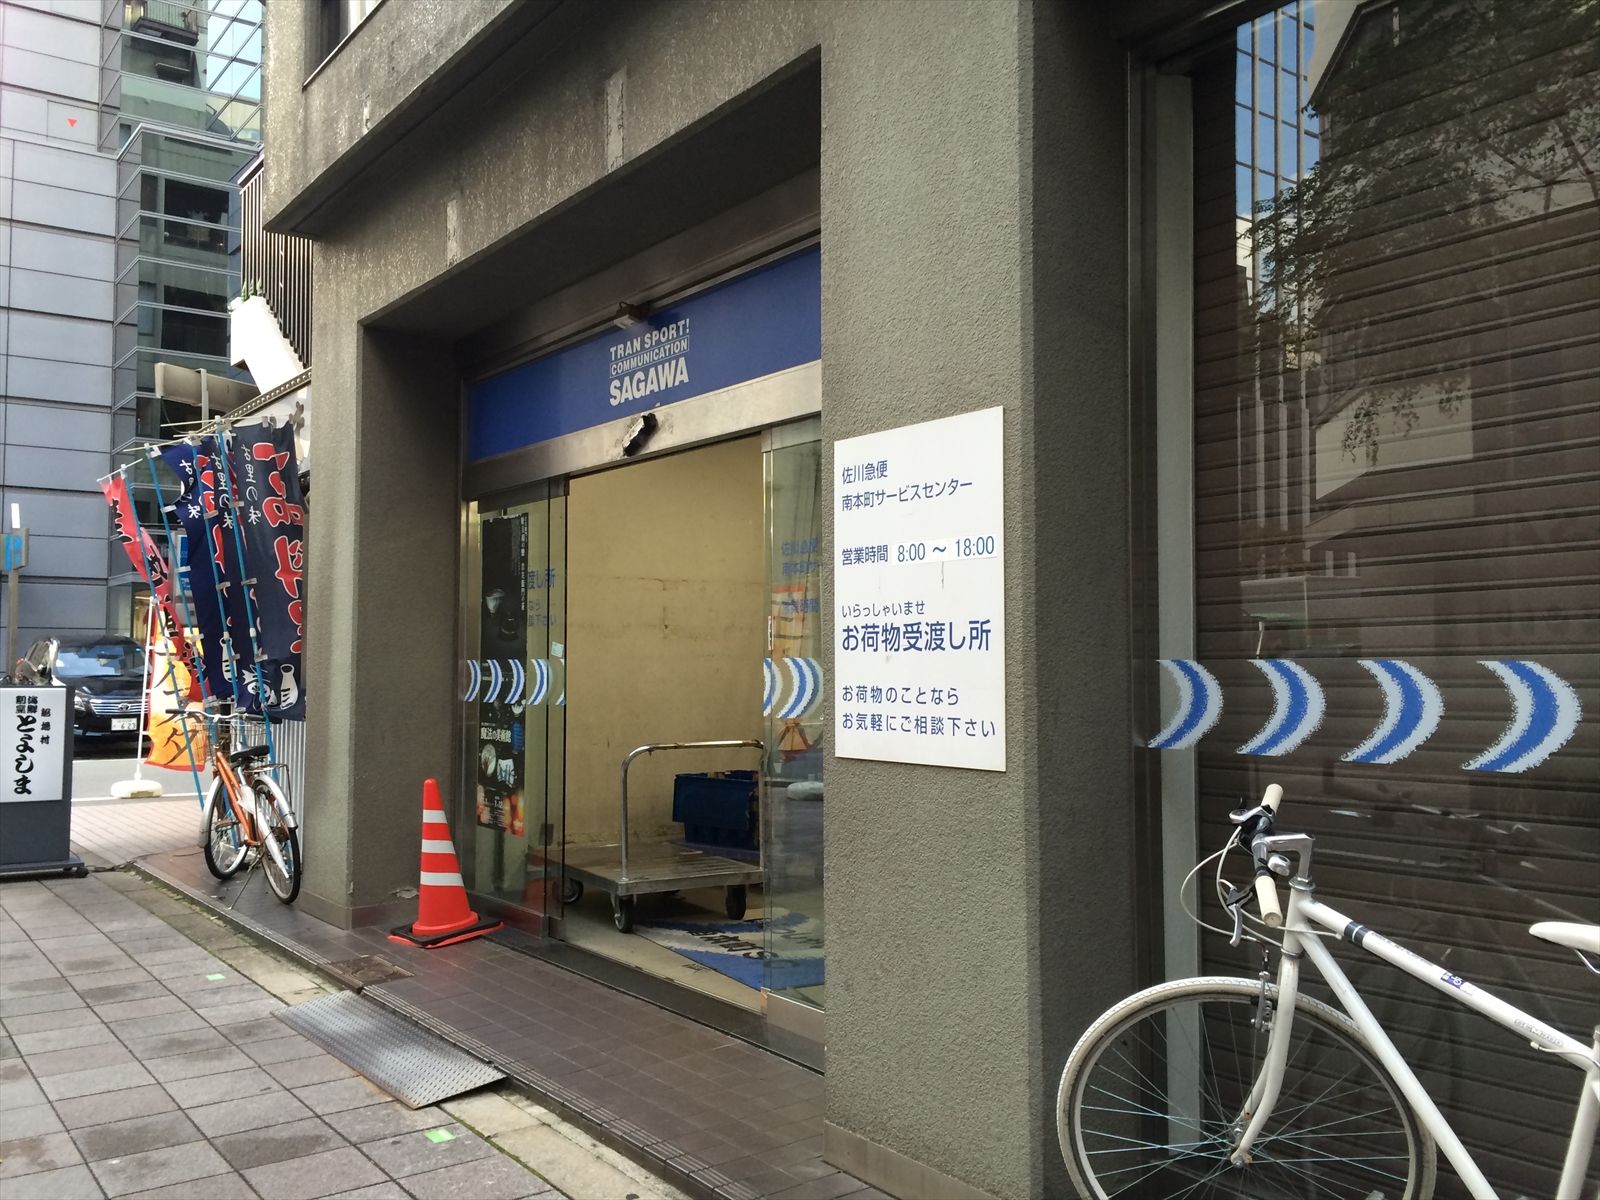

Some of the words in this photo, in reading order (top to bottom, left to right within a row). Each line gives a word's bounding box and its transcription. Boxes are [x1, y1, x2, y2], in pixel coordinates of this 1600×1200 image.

[611, 338, 688, 375] COMMUNICATION
[609, 356, 689, 407] SAGAWA
[841, 460, 888, 485] 佐川急便
[841, 478, 973, 512] 南本町サービスセンター
[841, 544, 889, 566] 営業時間
[897, 542, 926, 563] 8:00
[955, 535, 995, 557] 18:00
[841, 600, 926, 618] いらっしゃいませ
[842, 619, 992, 653] お荷物受渡し所
[842, 685, 960, 706] お荷物のことなら
[842, 712, 996, 738] お気軽にご相談下さい
[14, 715, 37, 795] とよしま
